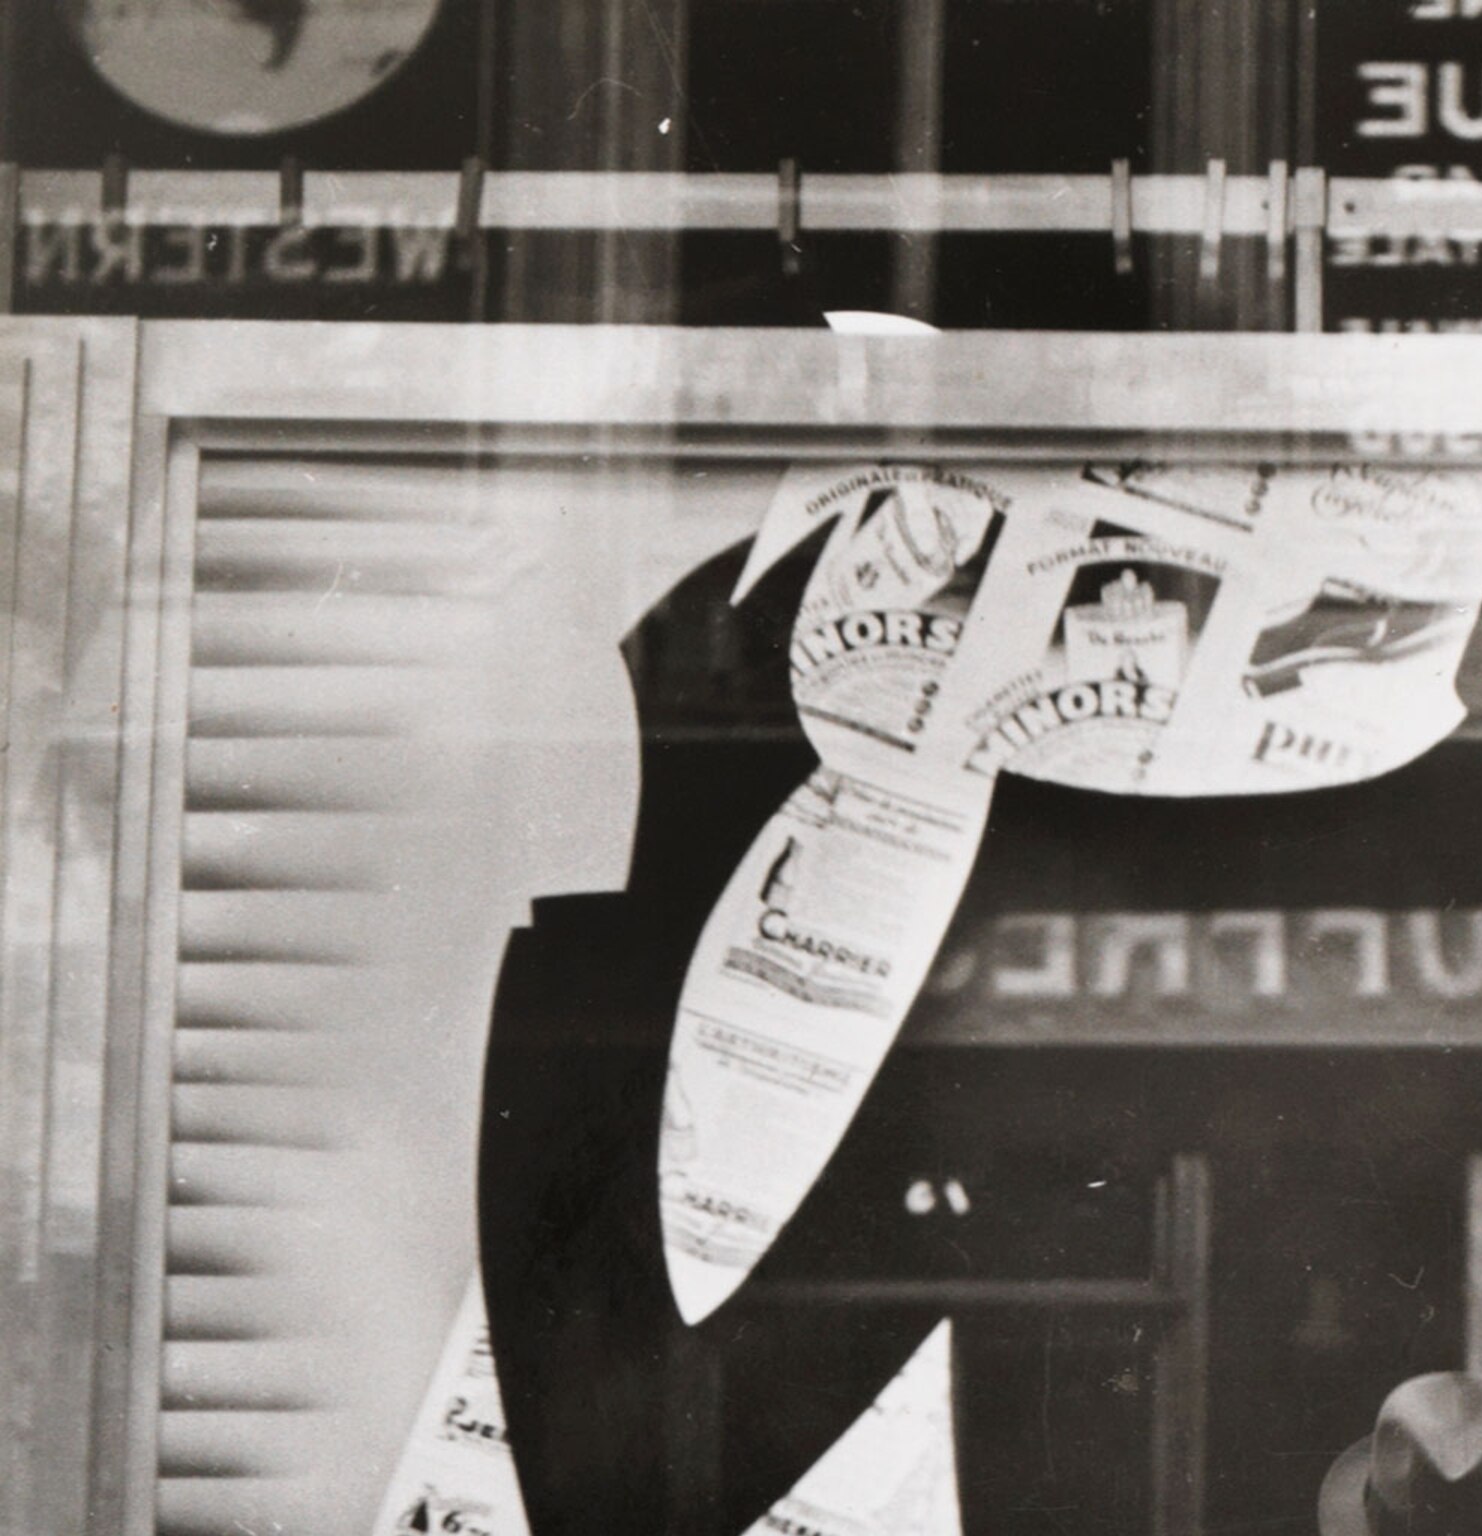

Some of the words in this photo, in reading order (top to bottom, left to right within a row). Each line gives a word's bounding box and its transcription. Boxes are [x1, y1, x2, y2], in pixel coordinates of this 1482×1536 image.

[1026, 539, 1110, 577] FORMAT
[1125, 539, 1228, 572] NOUVEAU
[789, 611, 963, 677] INORS
[963, 680, 1173, 781] MINORS
[758, 908, 893, 980] CHARRIER
